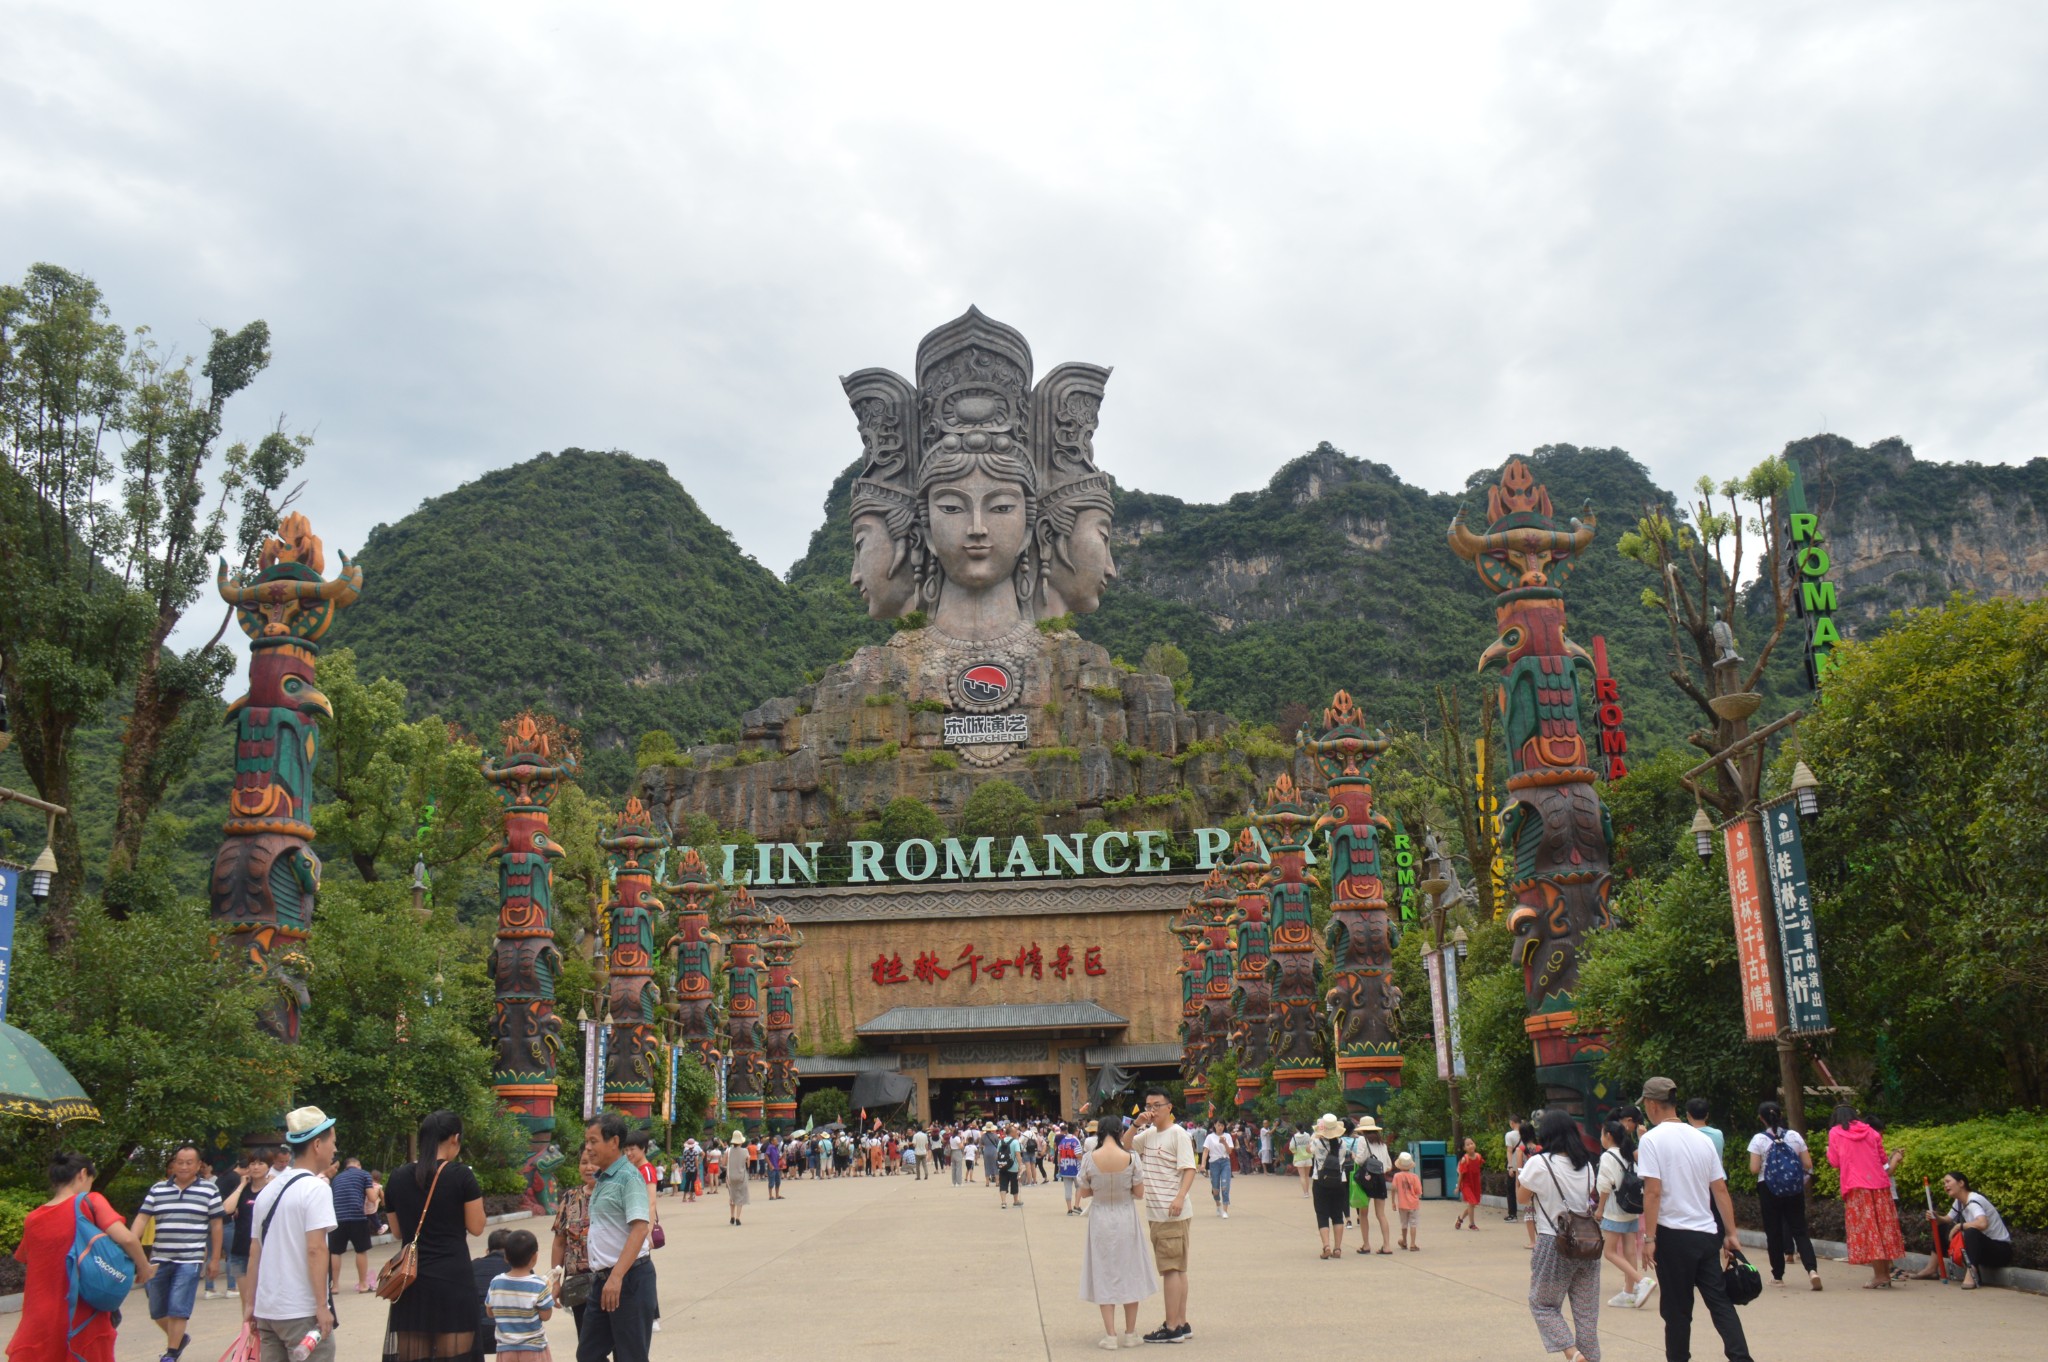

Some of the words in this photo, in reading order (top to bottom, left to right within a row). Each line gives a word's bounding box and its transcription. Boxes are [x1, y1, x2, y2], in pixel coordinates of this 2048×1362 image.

[944, 714, 1027, 735] 宋城演艺
[944, 733, 1027, 745] SONGCHENG
[847, 829, 1170, 883] ROMANCE
[870, 941, 1107, 986] 桂林千古情景区
[1735, 869, 1764, 1012] 桂林千古情
[1796, 880, 1823, 1008] 一生必看的演出
